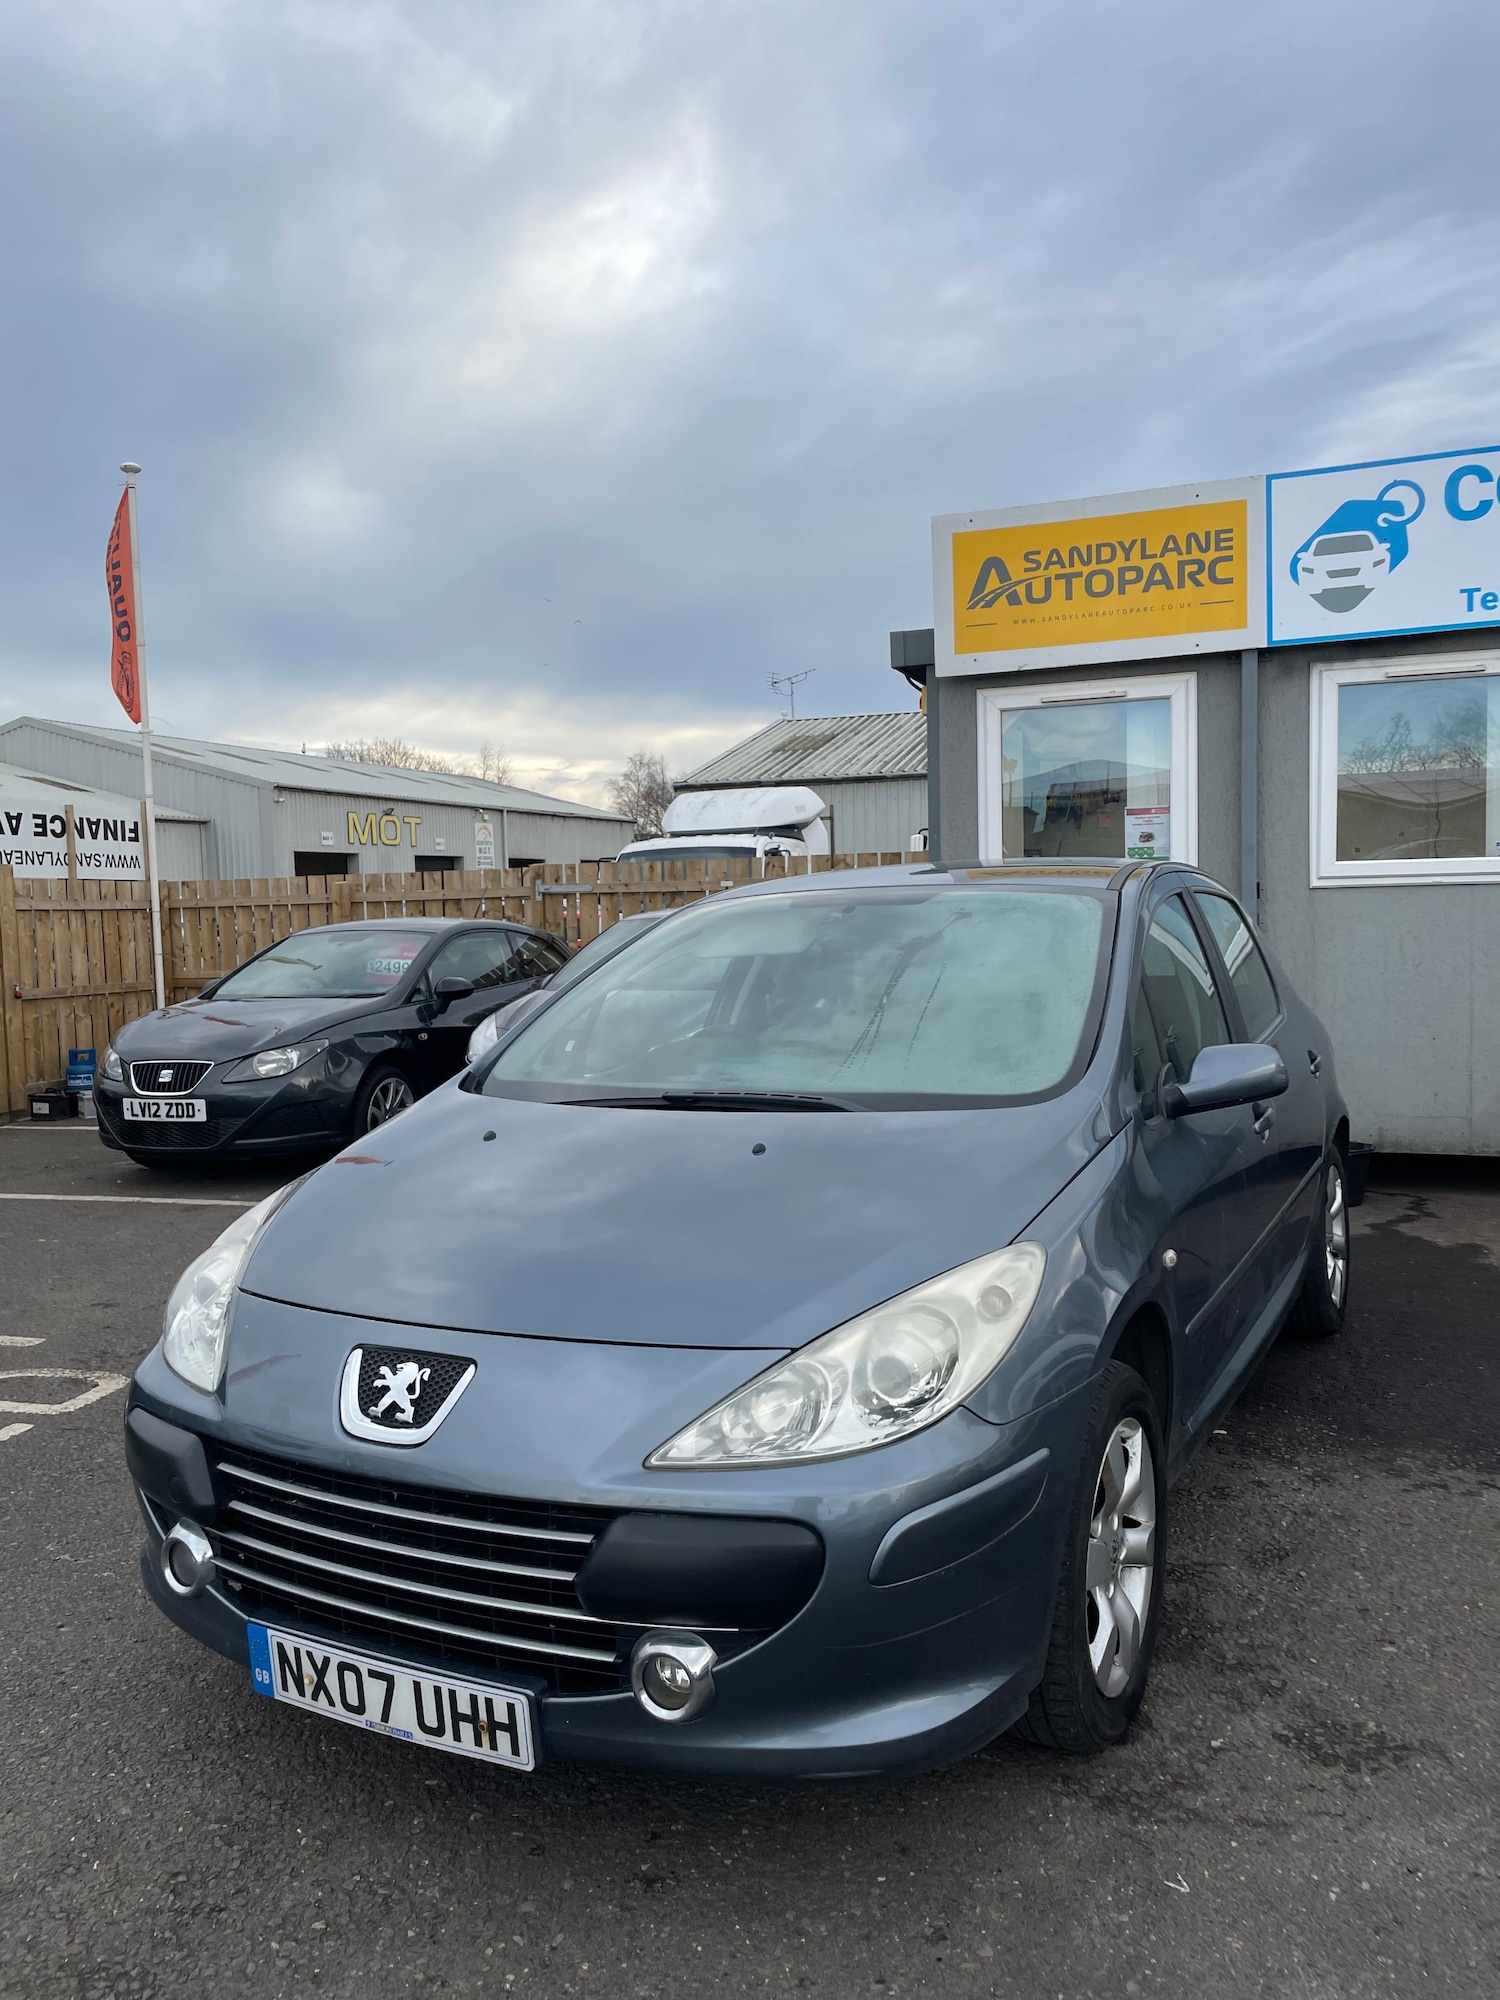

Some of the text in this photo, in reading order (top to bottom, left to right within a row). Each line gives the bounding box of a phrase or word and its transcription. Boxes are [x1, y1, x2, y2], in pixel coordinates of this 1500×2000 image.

[1444, 464, 1500, 522] C
[1023, 528, 1234, 573] SANDYLANE
[966, 555, 1234, 610] AUTOPARC
[1013, 602, 1193, 625] WWW.SANDYLANEAUTOPARC.CO.UK
[32, 813, 140, 842] FINANCE
[346, 811, 422, 848] MOT
[0, 849, 141, 869] WWW.SANYLANEA
[130, 1101, 195, 1119] LV12 ZDD
[254, 1667, 270, 1685] GB
[276, 1641, 521, 1758] NX07 UHH
